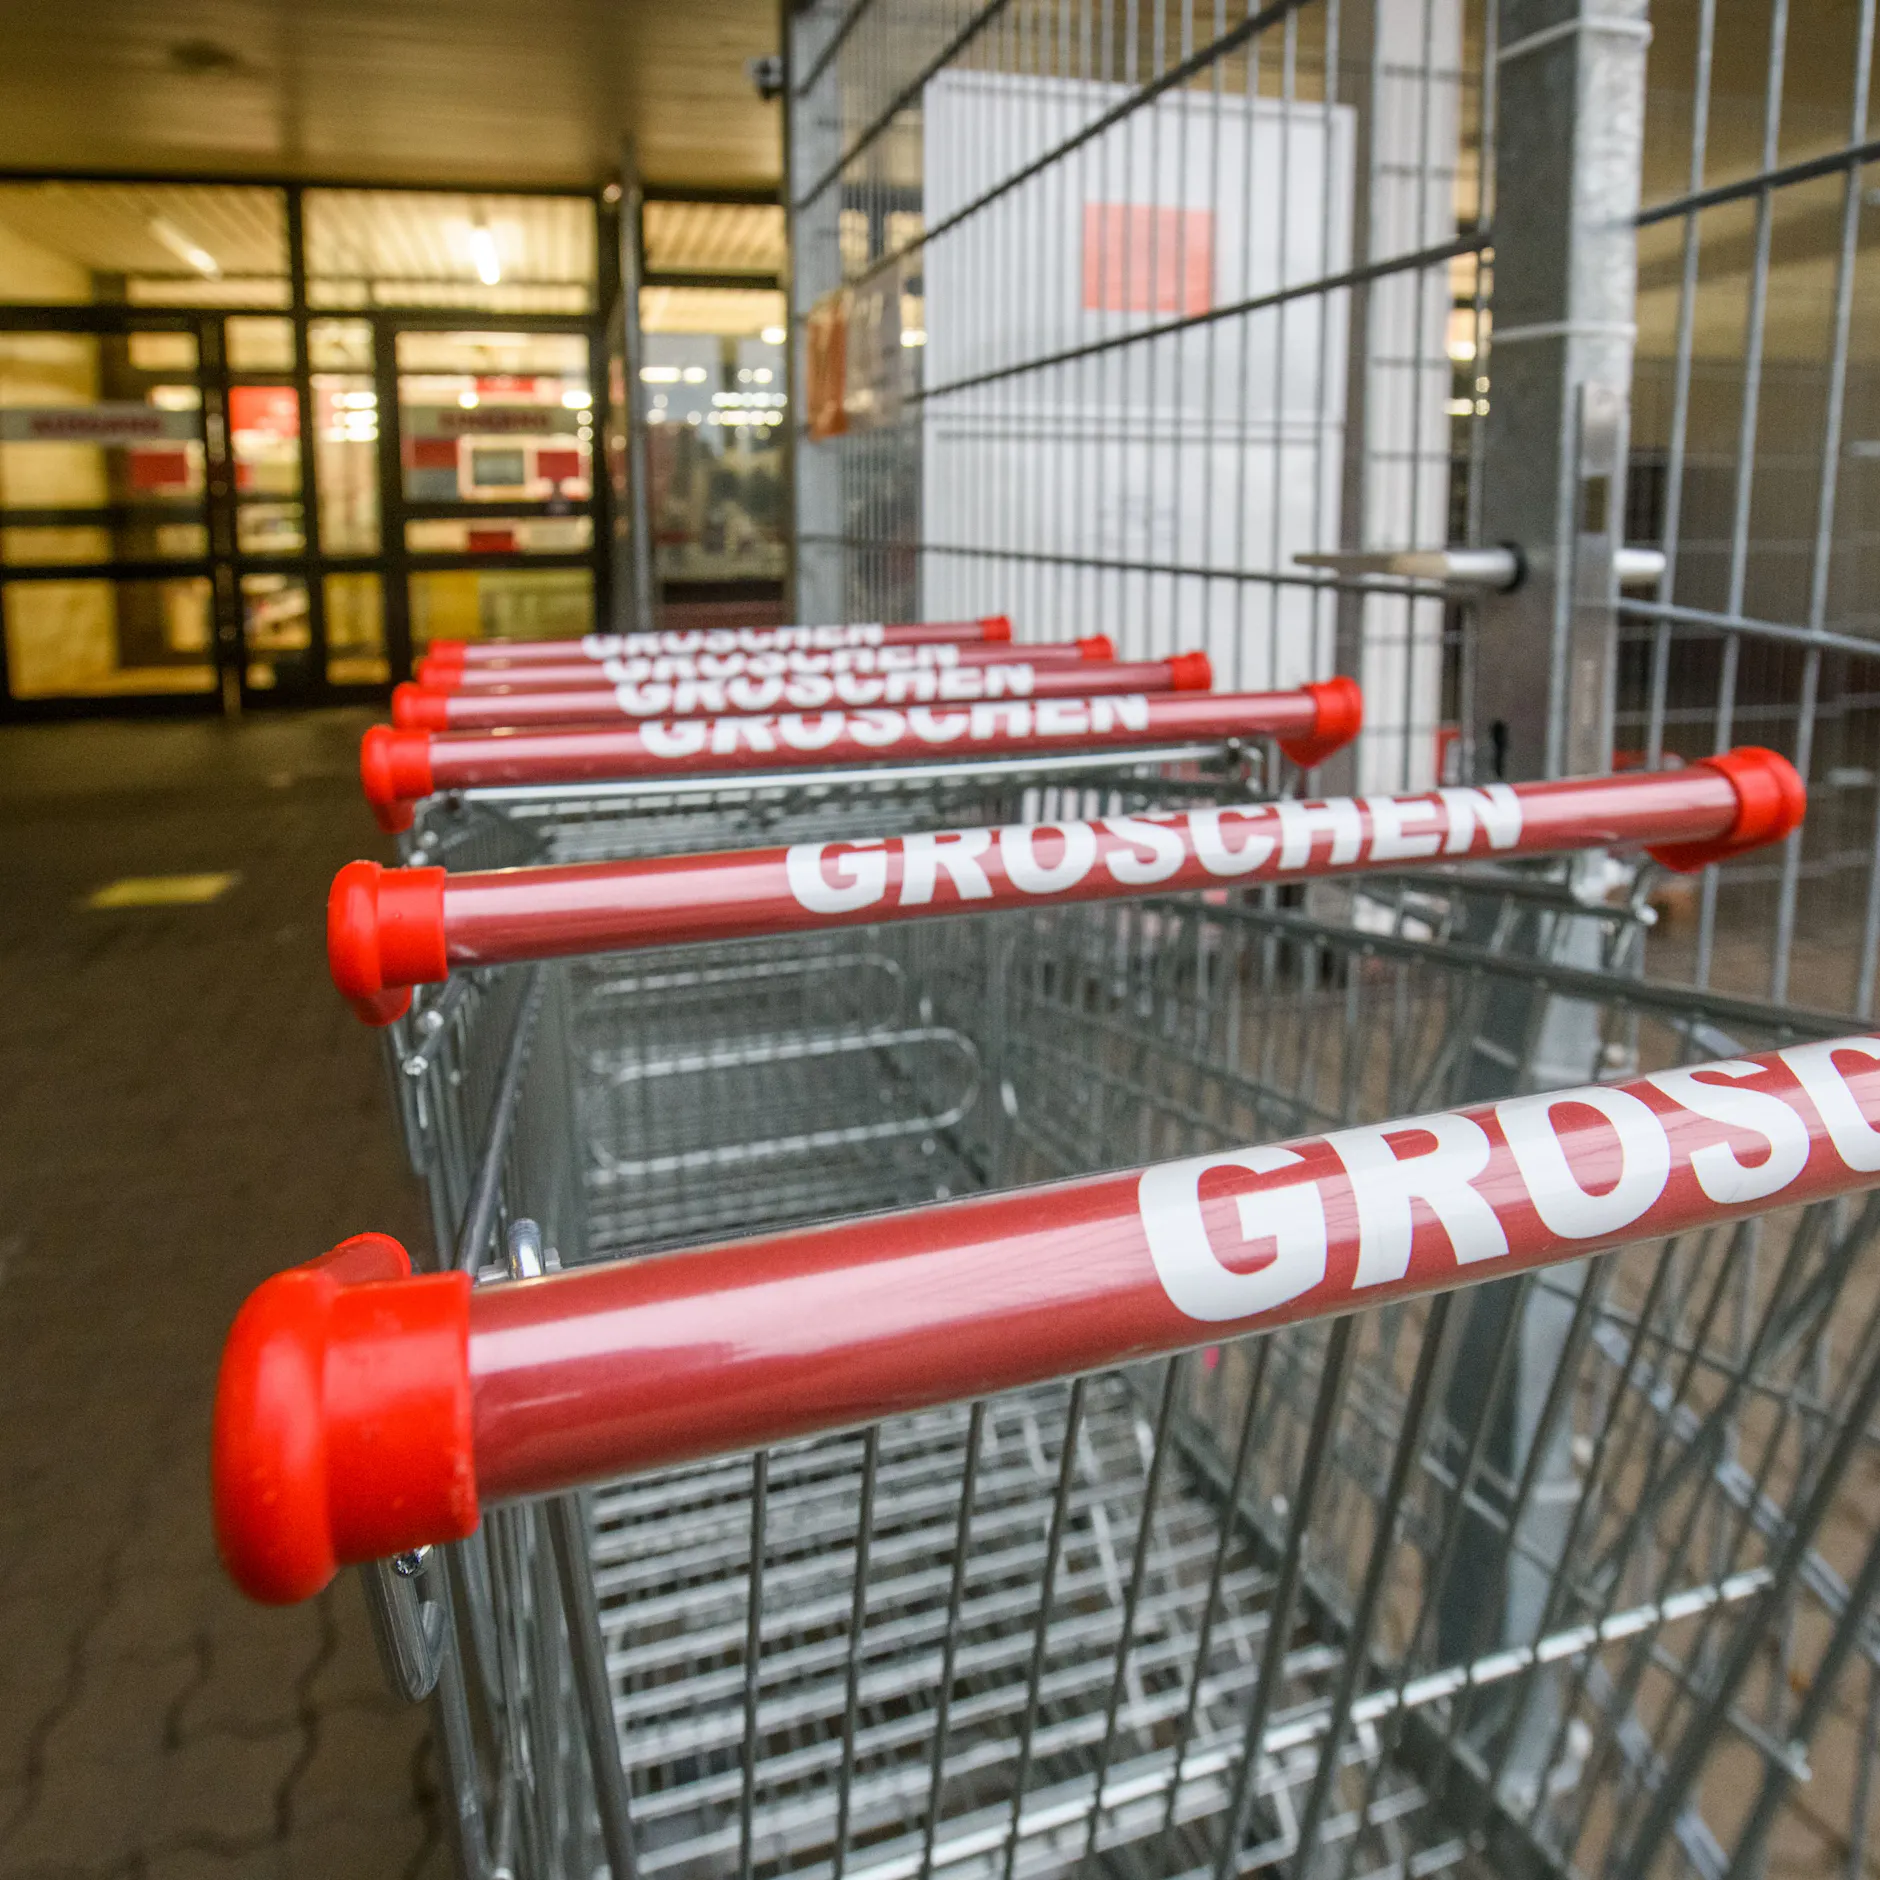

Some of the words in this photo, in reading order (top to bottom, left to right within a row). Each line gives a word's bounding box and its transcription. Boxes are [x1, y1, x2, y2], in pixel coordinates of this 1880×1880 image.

[615, 664, 1035, 715] GROSCHEN
[639, 694, 1149, 757] GROSCHEN
[786, 784, 1523, 914] GROSCHEN
